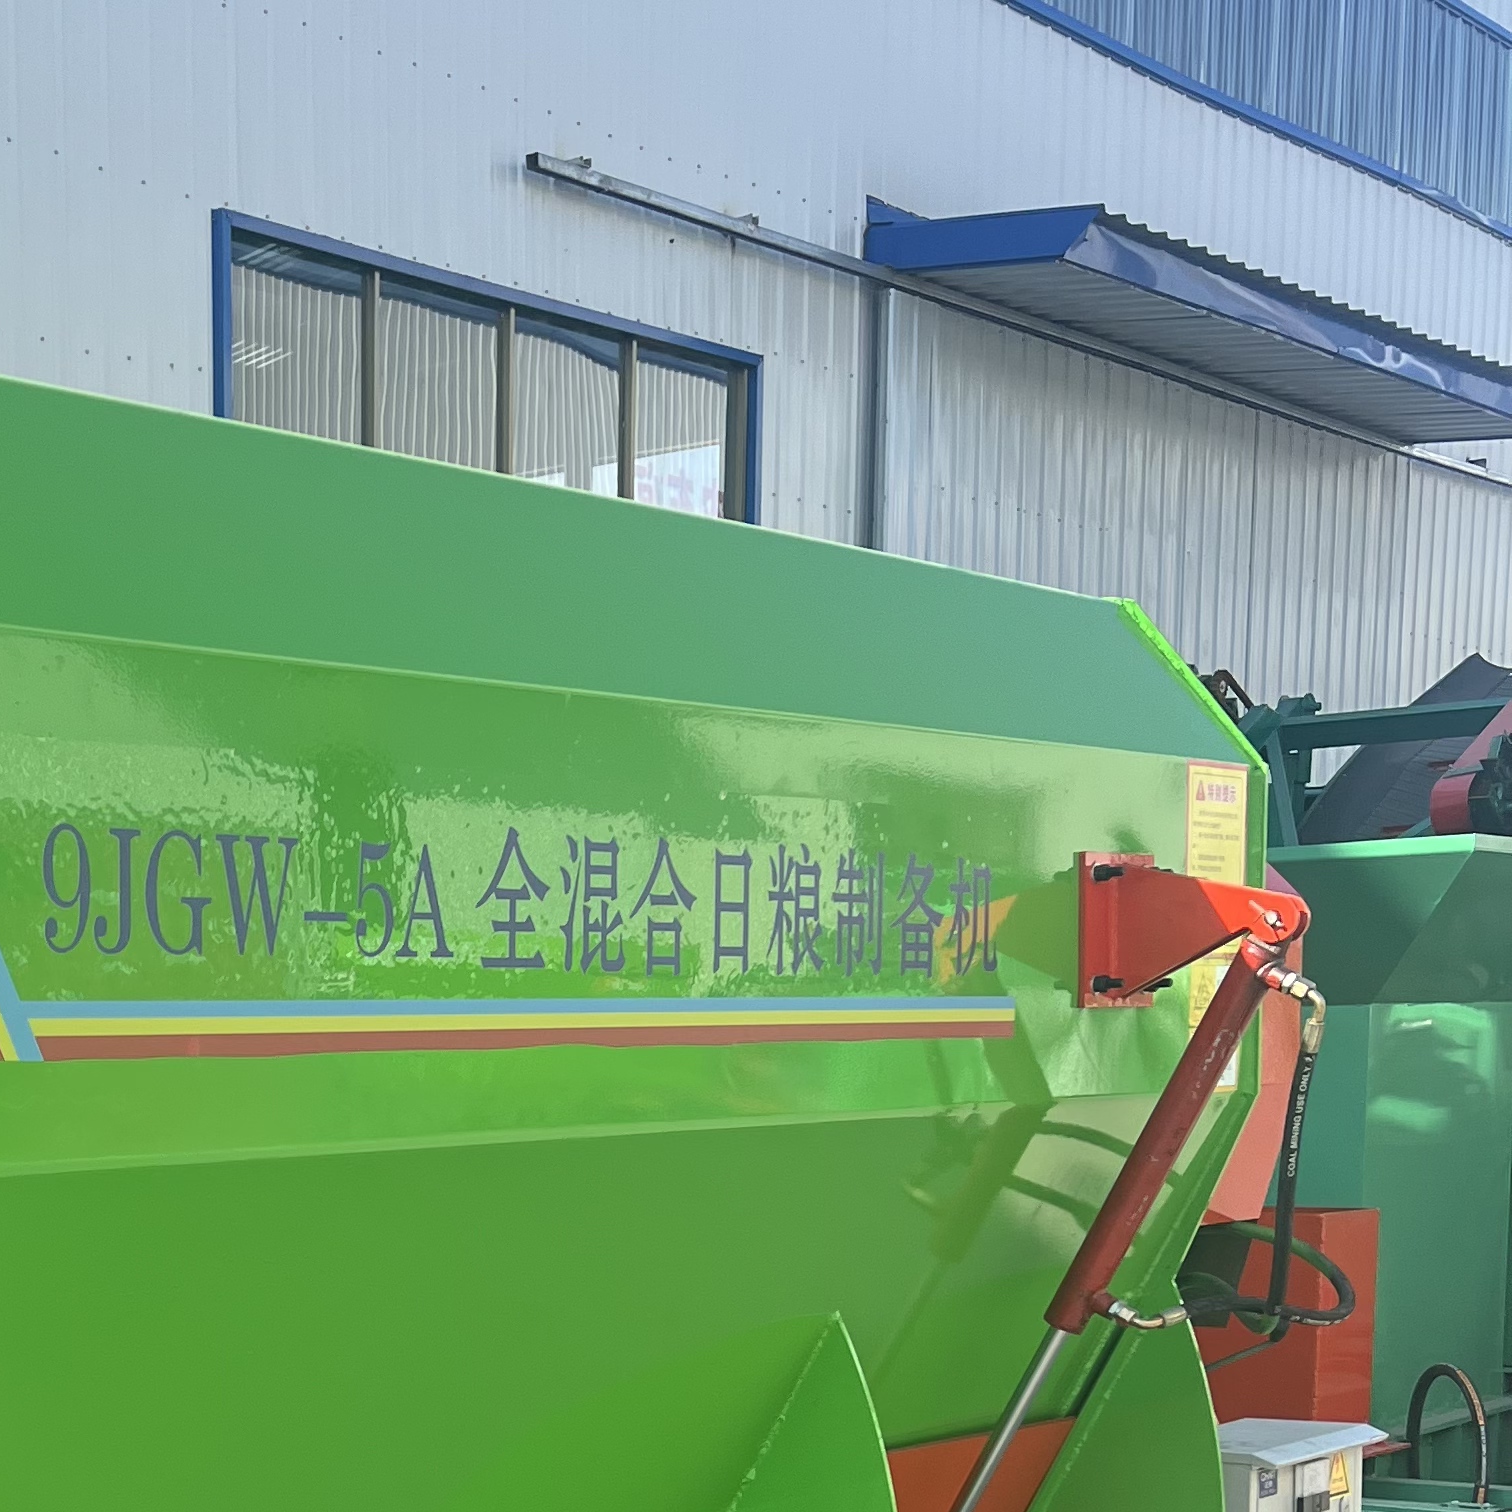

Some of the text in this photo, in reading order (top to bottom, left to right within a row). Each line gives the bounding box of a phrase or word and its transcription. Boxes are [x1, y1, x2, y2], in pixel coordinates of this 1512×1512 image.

[42, 822, 998, 979] 9JGW-5A 全混合日粮制备机
[1286, 1066, 1312, 1178] COAL MINING USE ONLY
